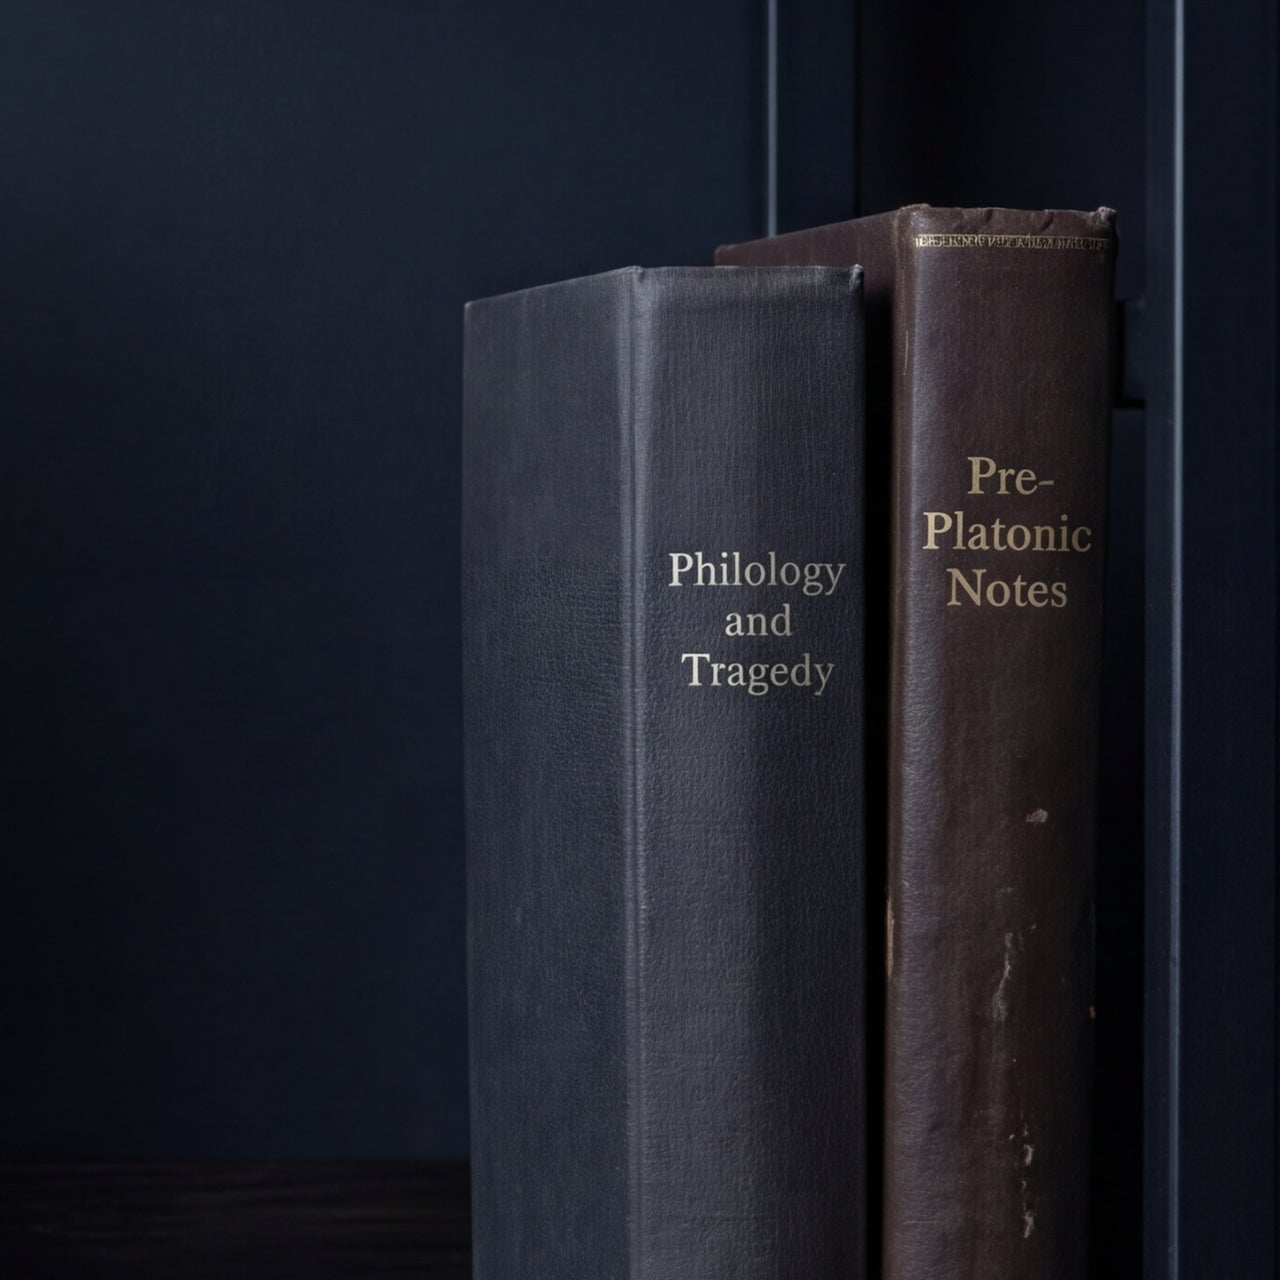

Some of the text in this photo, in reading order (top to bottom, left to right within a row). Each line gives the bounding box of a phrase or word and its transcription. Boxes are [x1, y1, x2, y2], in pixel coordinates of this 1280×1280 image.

[967, 456, 1055, 495] Pre-
[922, 511, 1092, 553] Platonic
[668, 551, 847, 596] Philology
[946, 568, 1068, 608] Notes
[725, 604, 793, 637] and
[681, 653, 835, 696] Tragedy
